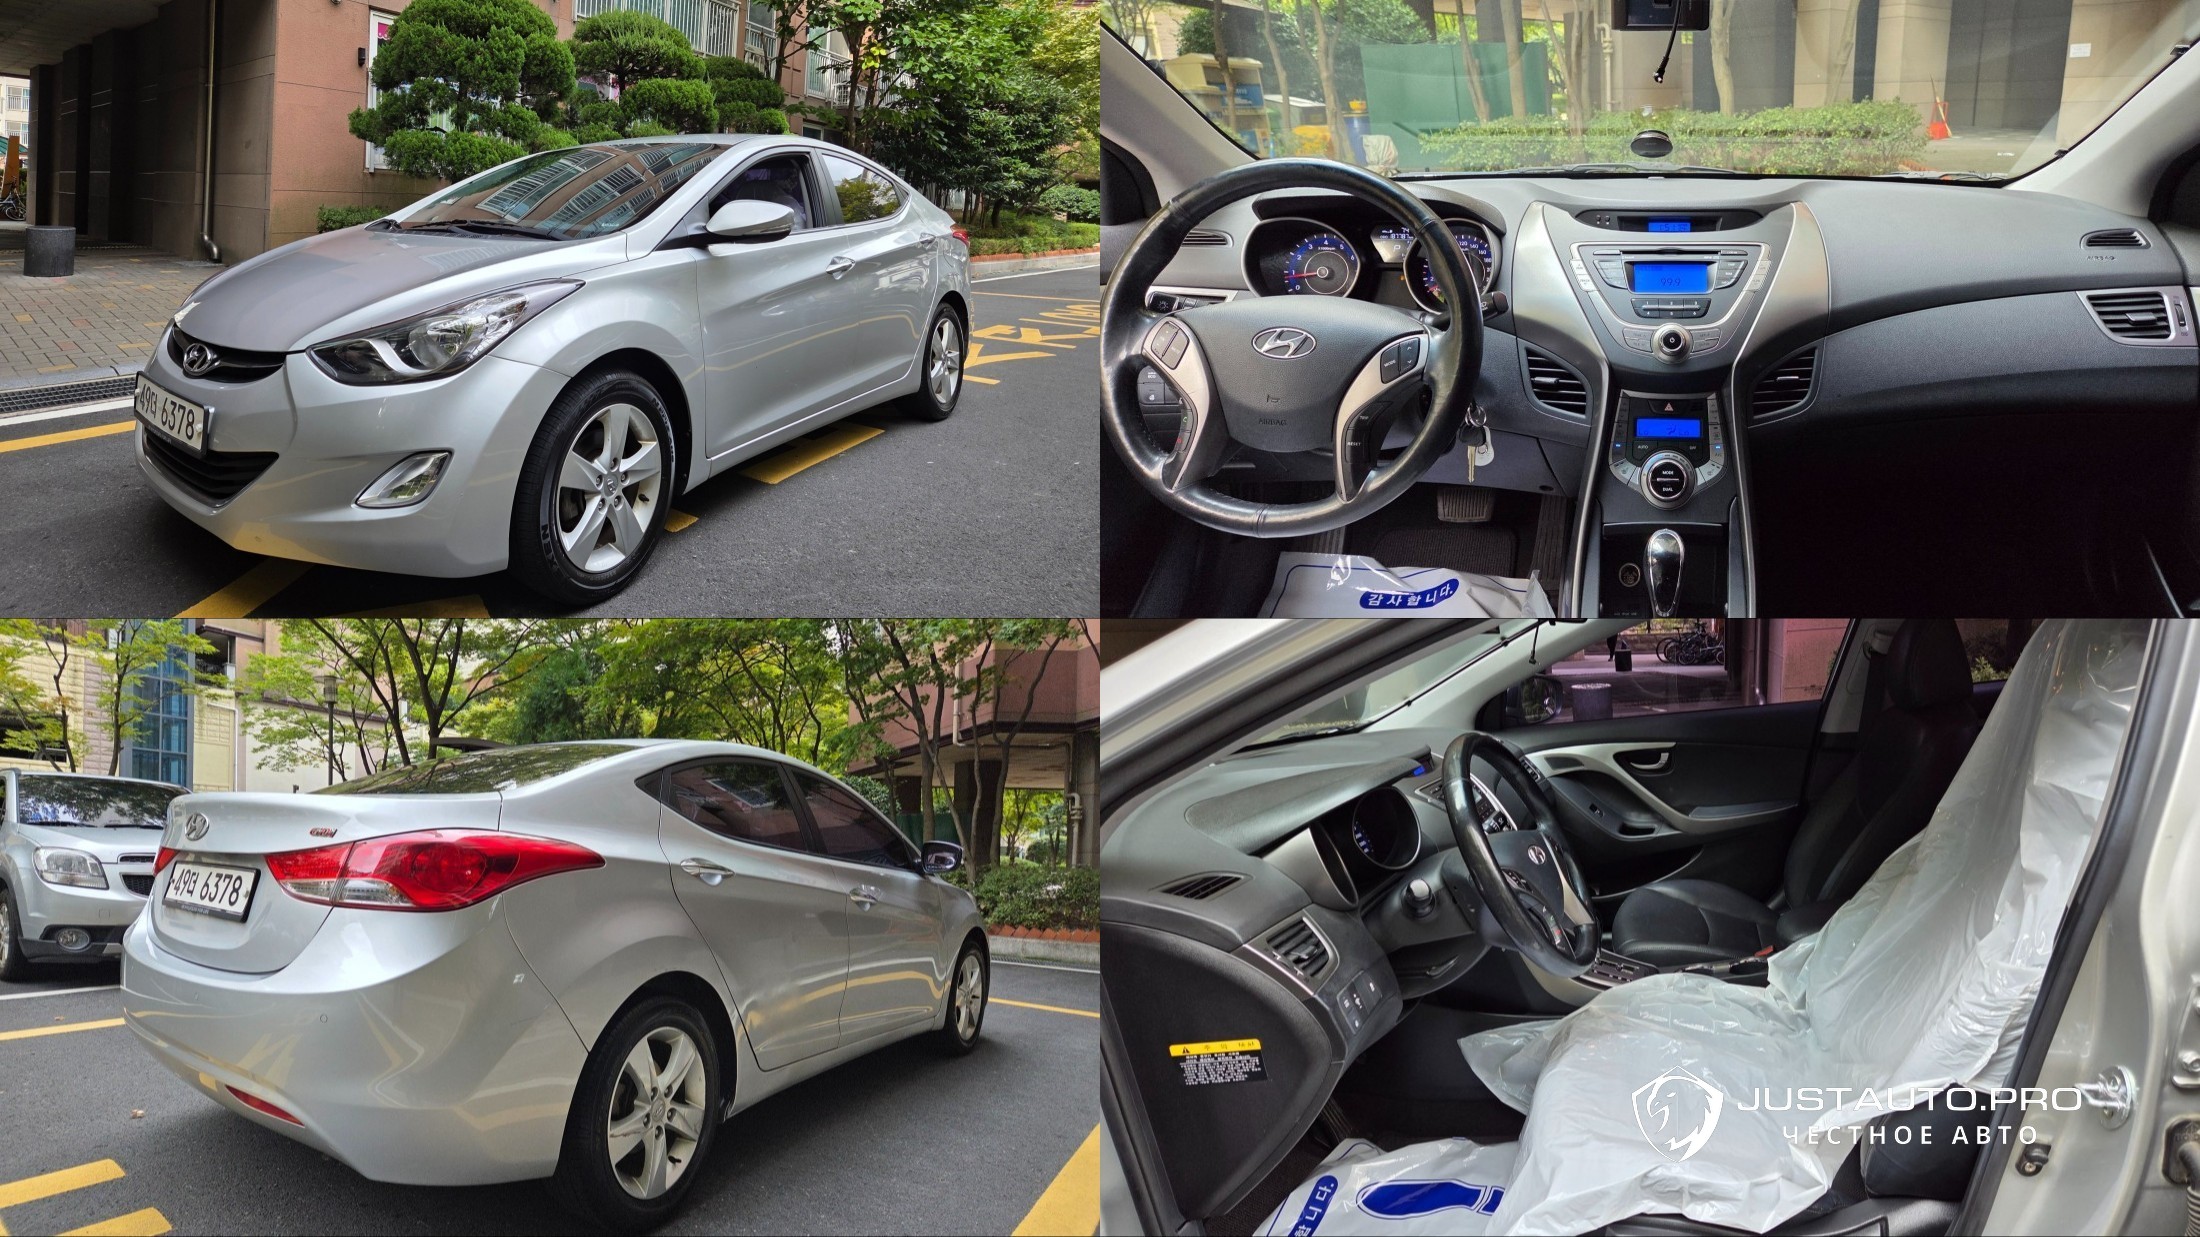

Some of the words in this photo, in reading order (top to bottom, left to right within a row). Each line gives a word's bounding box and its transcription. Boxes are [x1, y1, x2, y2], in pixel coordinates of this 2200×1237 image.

[161, 397, 195, 440] 6378
[1258, 417, 1288, 426] AIRBAG
[200, 871, 243, 907] 6378
